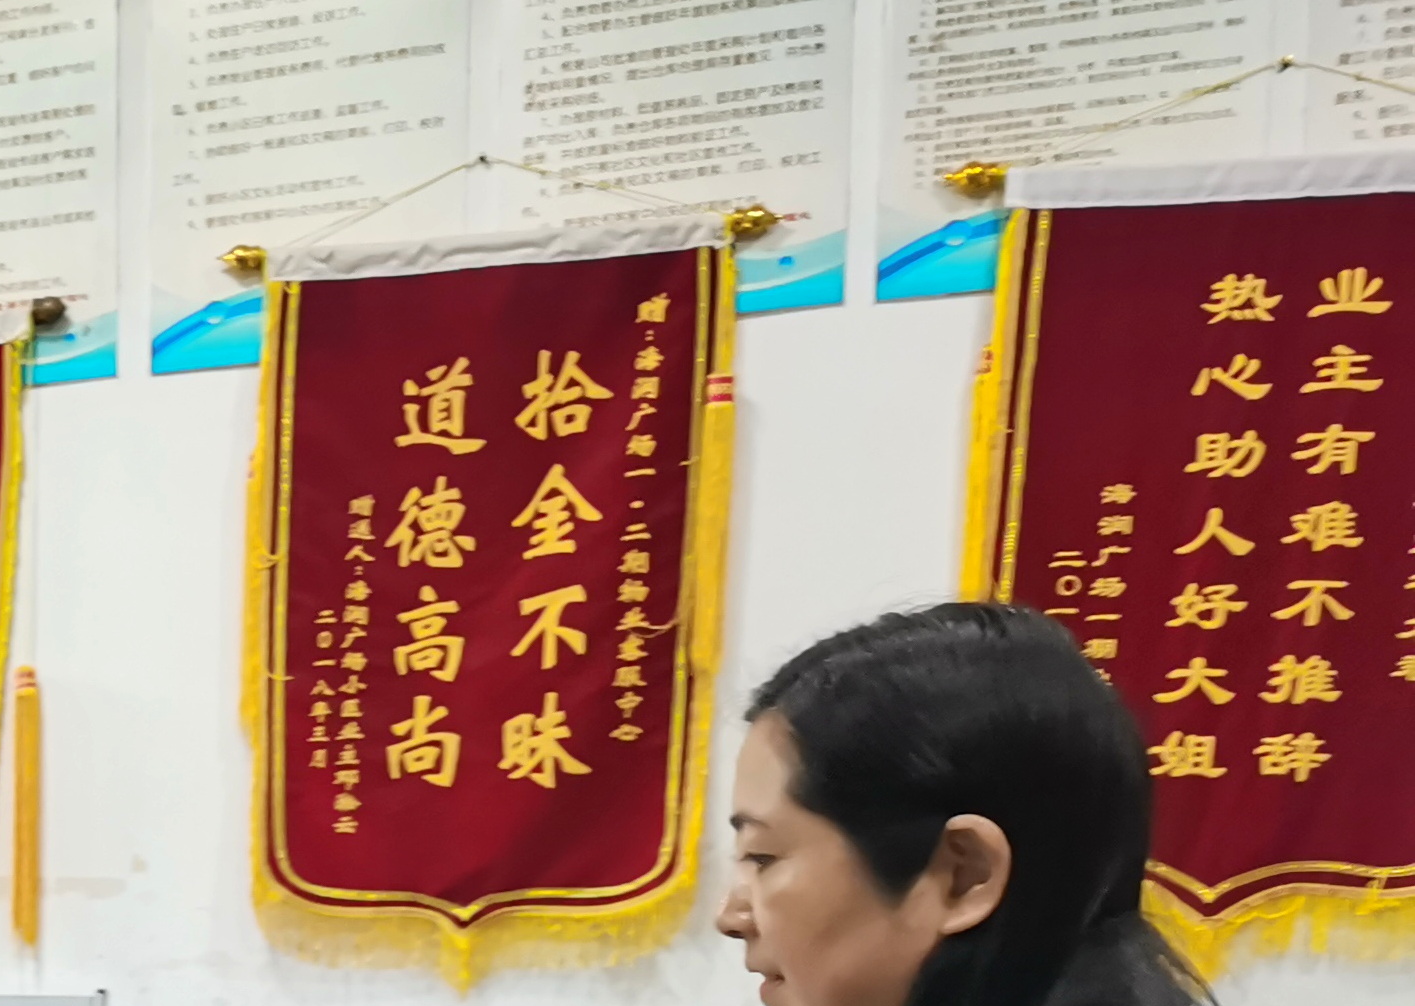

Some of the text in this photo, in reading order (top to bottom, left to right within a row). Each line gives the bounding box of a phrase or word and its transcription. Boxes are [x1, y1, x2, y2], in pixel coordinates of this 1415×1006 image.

[383, 356, 488, 788] 道德高尚
[496, 349, 615, 789] 拾金不昧
[1146, 273, 1284, 778] 热心助人好大姐
[1252, 266, 1394, 783] 业主有难不推辞
